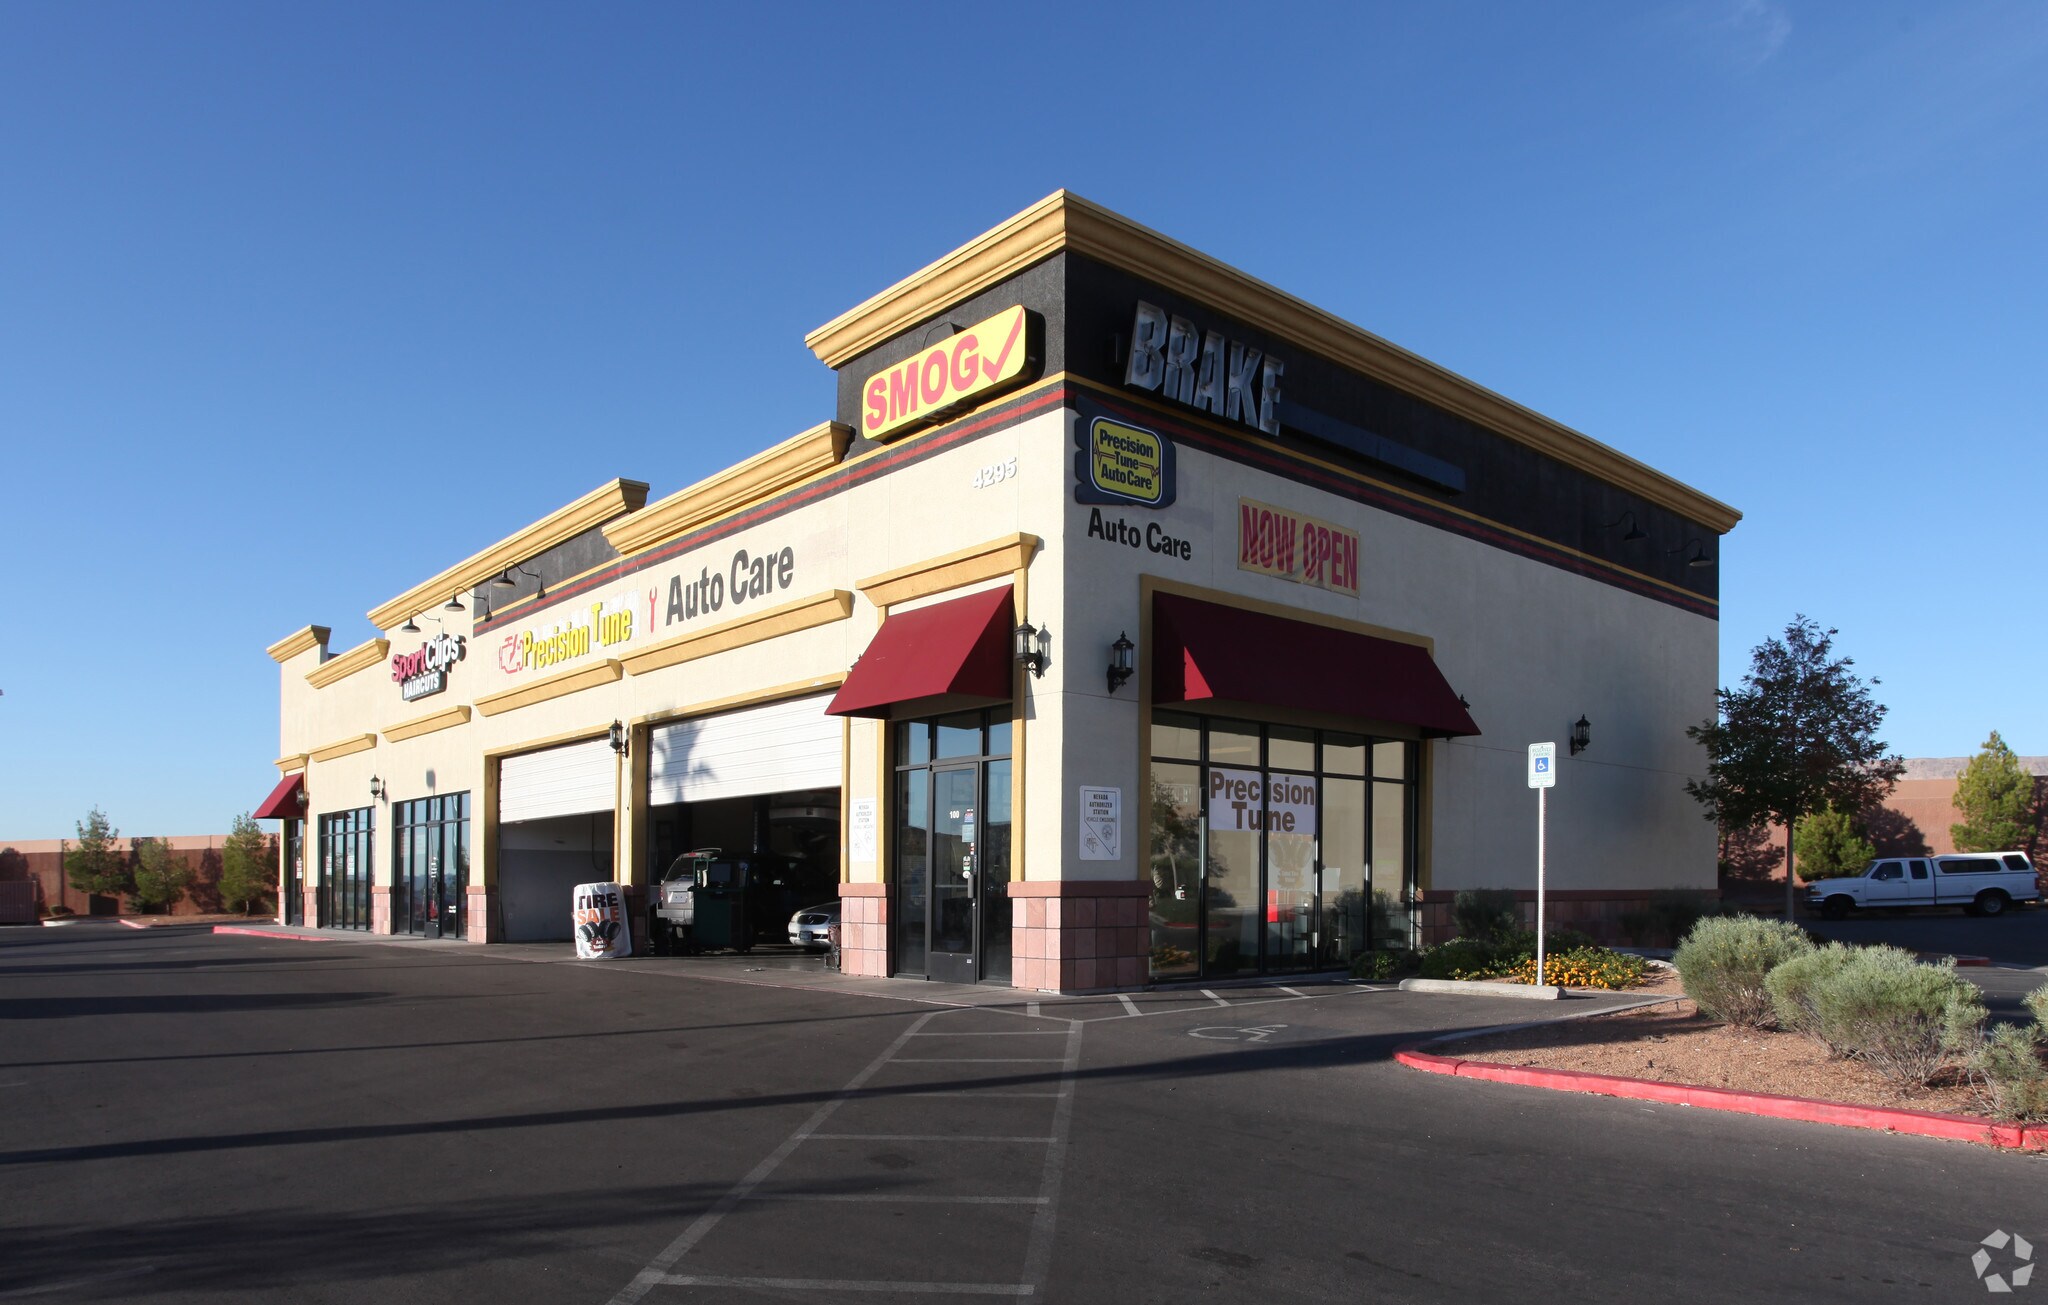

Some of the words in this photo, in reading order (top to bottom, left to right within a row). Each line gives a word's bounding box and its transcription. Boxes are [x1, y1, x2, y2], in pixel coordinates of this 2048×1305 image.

[866, 334, 979, 430] SMOG
[1125, 299, 1284, 437] BRAKE
[1099, 428, 1154, 459] Precision
[1114, 450, 1139, 471] Tune
[971, 456, 1018, 490] 4295
[1087, 506, 1142, 549] Auto
[1146, 521, 1192, 561] Care
[1241, 504, 1297, 575] NOW
[1302, 521, 1358, 592] OPEN
[665, 565, 724, 627] Auto
[730, 546, 794, 605] Care
[522, 623, 590, 671] Precision
[591, 601, 633, 648] Tune
[403, 671, 440, 700] HAIRCUTS
[1209, 771, 1315, 806] Precision
[949, 810, 960, 819] 100
[1231, 801, 1296, 832] Tune
[577, 906, 620, 925] SALE
[579, 893, 618, 909] TIRE
